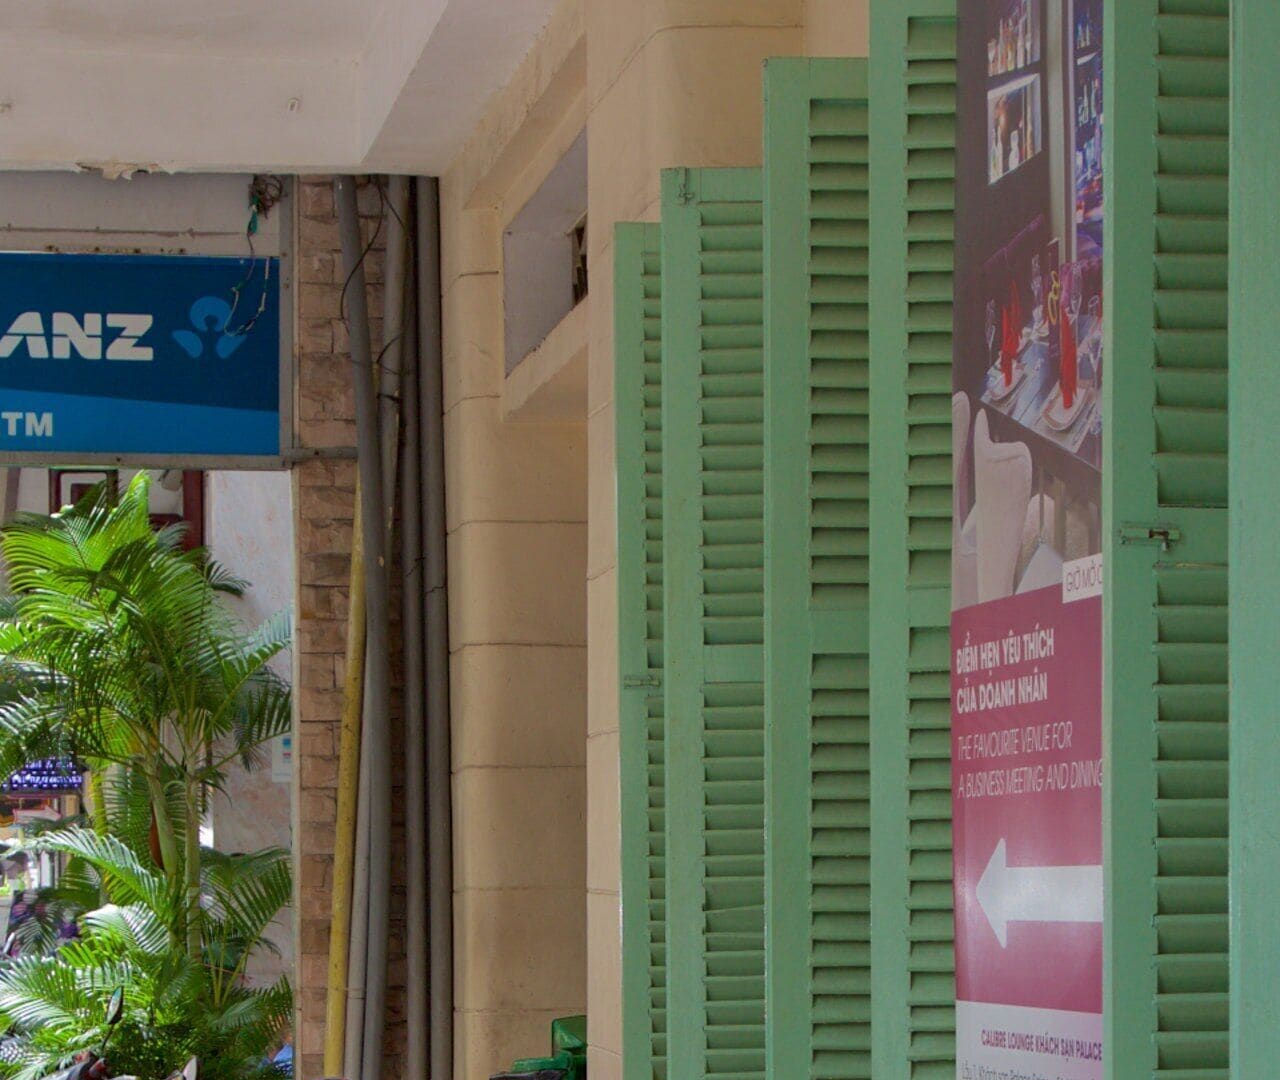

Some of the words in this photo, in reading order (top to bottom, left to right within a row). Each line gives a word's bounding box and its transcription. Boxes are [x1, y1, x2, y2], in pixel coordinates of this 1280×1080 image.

[979, 678, 1016, 711] DOANH
[958, 735, 972, 760] THE
[973, 728, 1019, 759] FAVOURITE
[1021, 723, 1050, 753] VENUE
[1052, 721, 1073, 749] FOR
[1045, 762, 1069, 791] AND
[1008, 1032, 1034, 1052] LOUNGE
[1076, 1039, 1102, 1062] PALACE
